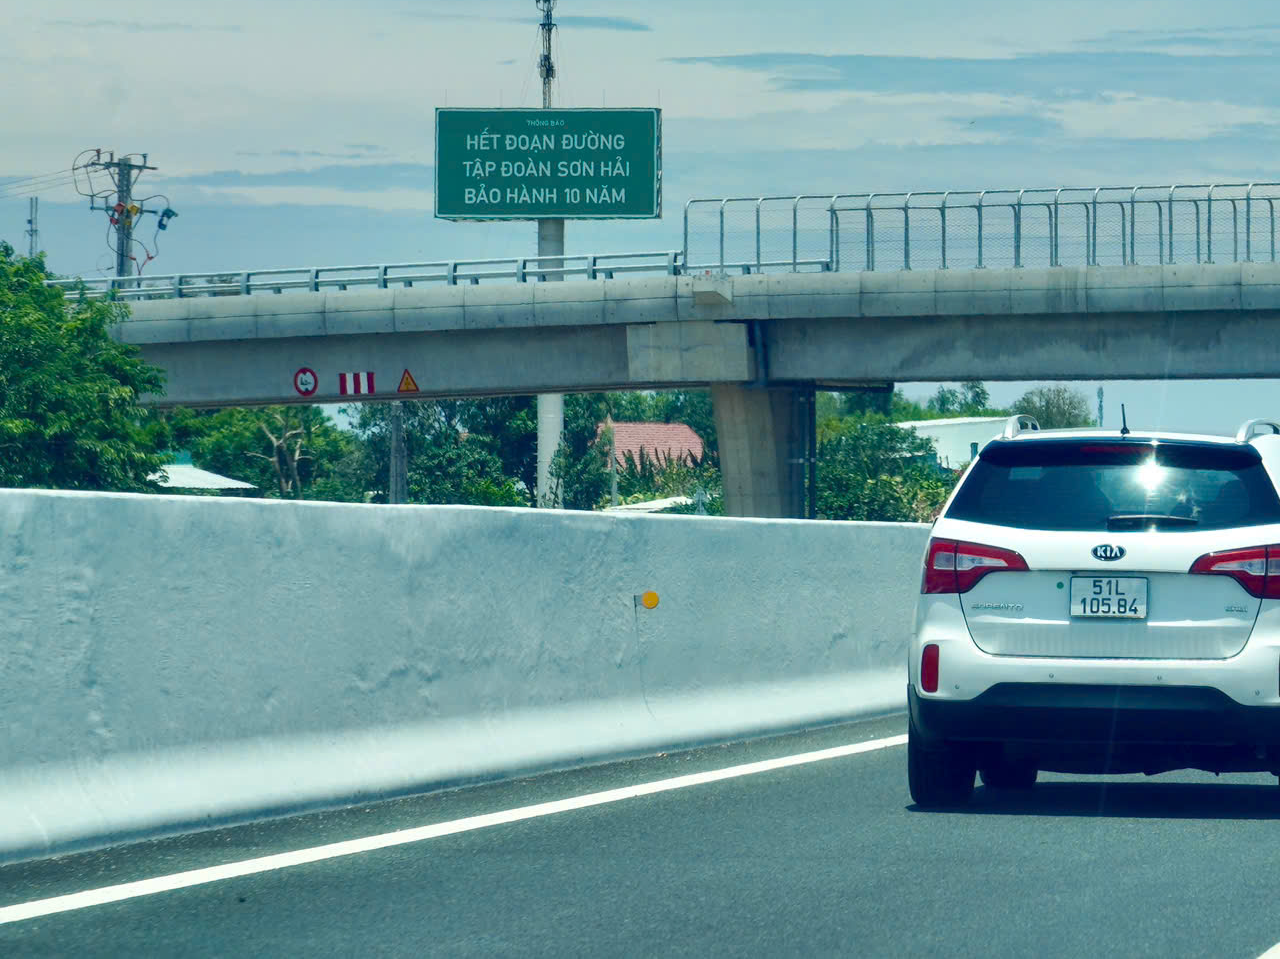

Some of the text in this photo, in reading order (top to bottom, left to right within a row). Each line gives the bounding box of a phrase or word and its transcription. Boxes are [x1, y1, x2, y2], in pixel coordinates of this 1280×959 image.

[467, 128, 625, 152] HẾT ĐOẠN ĐƯỜNG
[463, 156, 630, 179] TẬP ĐOÀN SƠN HẢI
[464, 184, 625, 204] BẢO HÀNH 10 NĂM
[1096, 546, 1121, 557] KIA
[1092, 579, 1125, 595] 51L
[1080, 597, 1138, 614] 105.84
